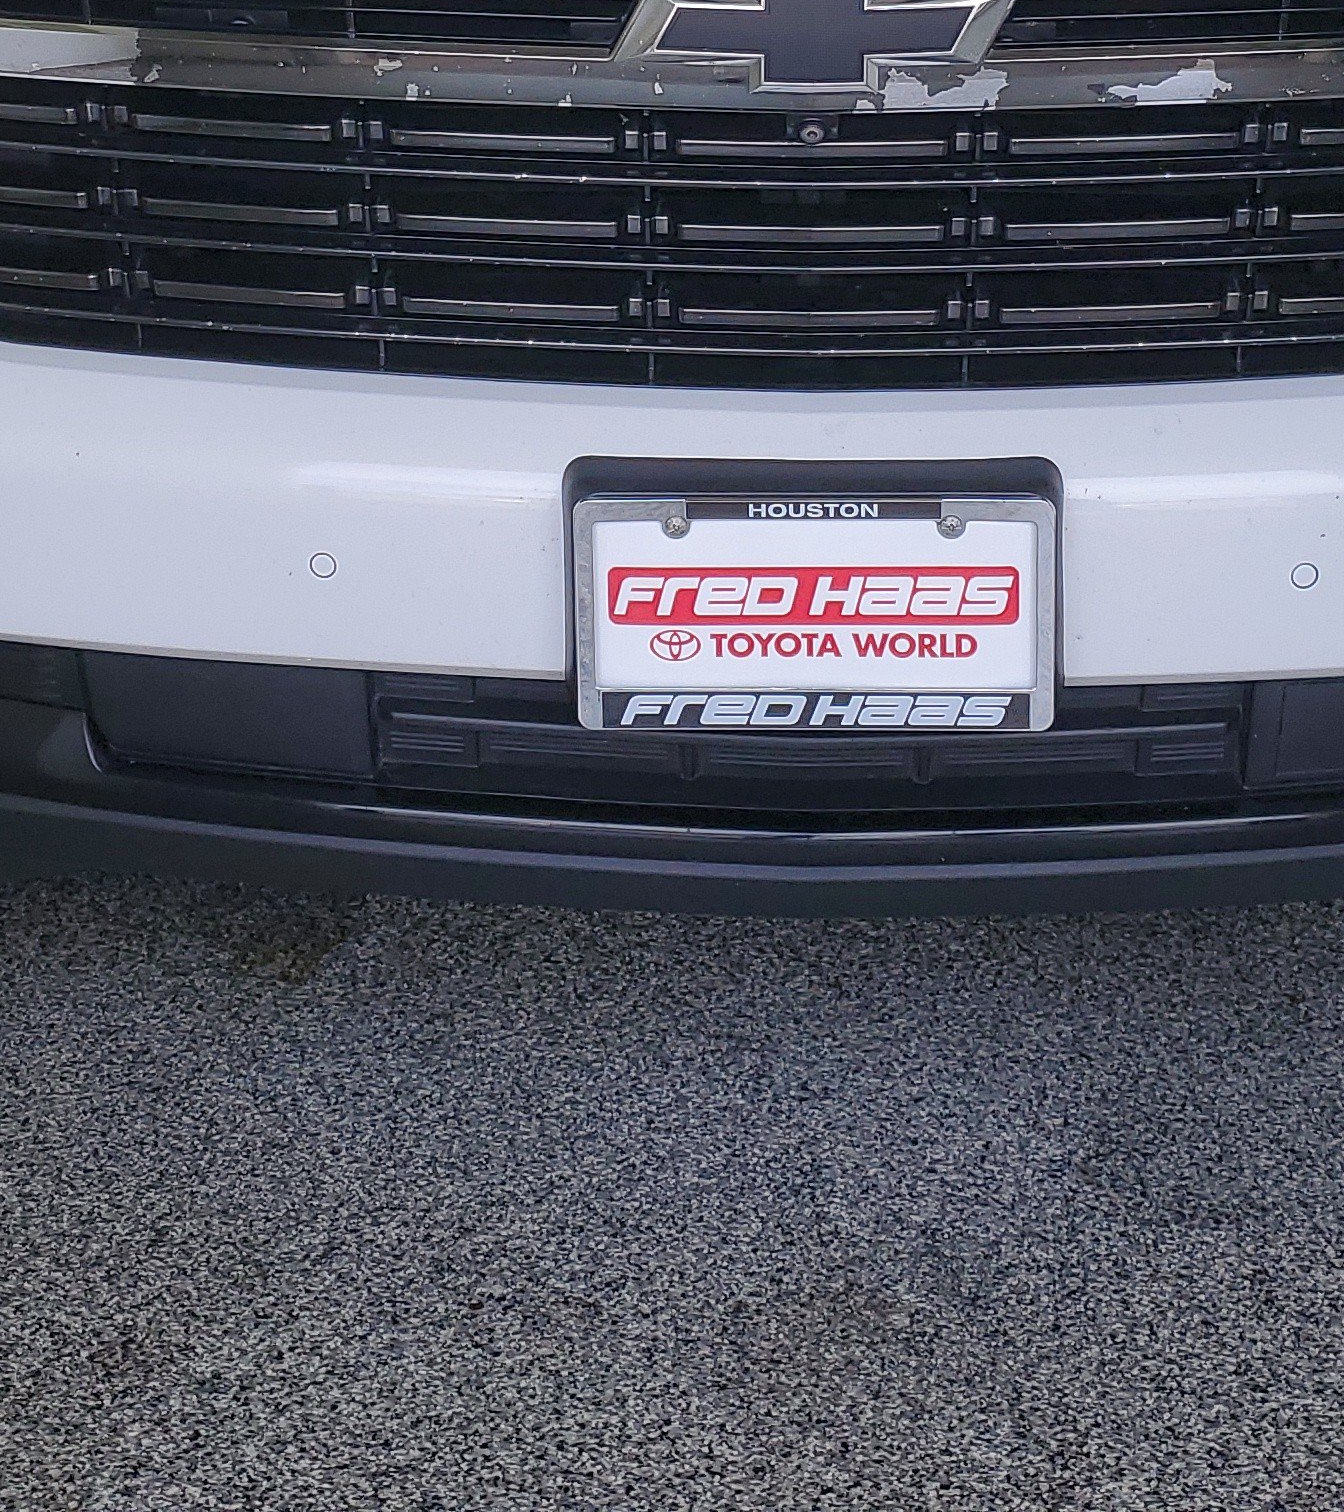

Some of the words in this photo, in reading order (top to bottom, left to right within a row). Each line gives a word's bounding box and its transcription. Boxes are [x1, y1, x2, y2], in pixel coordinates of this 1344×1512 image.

[748, 503, 879, 518] HOUSTON
[709, 632, 841, 658] TOYOTA
[852, 632, 978, 658] WORLD
